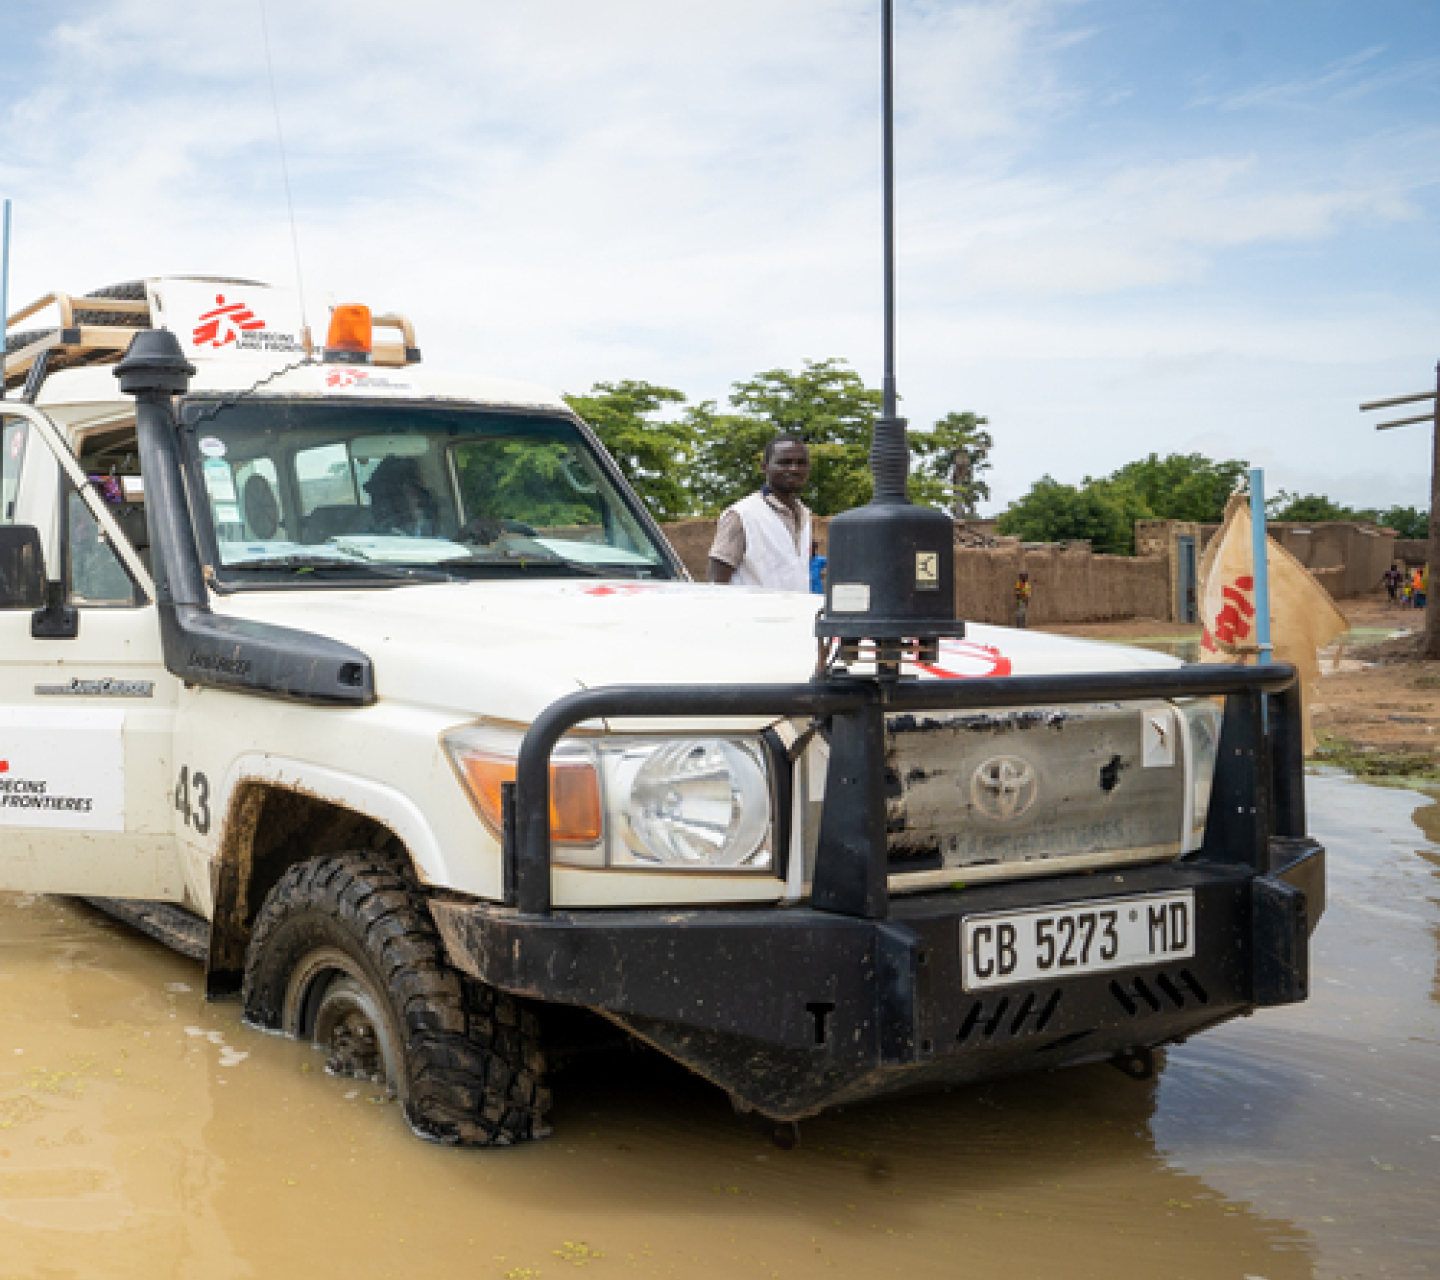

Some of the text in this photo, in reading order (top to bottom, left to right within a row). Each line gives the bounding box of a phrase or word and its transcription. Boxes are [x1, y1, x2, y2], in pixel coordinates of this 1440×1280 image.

[0, 795, 93, 813] FRONTIERES
[175, 764, 211, 836] 43
[972, 900, 1188, 980] CB 5273 MD
